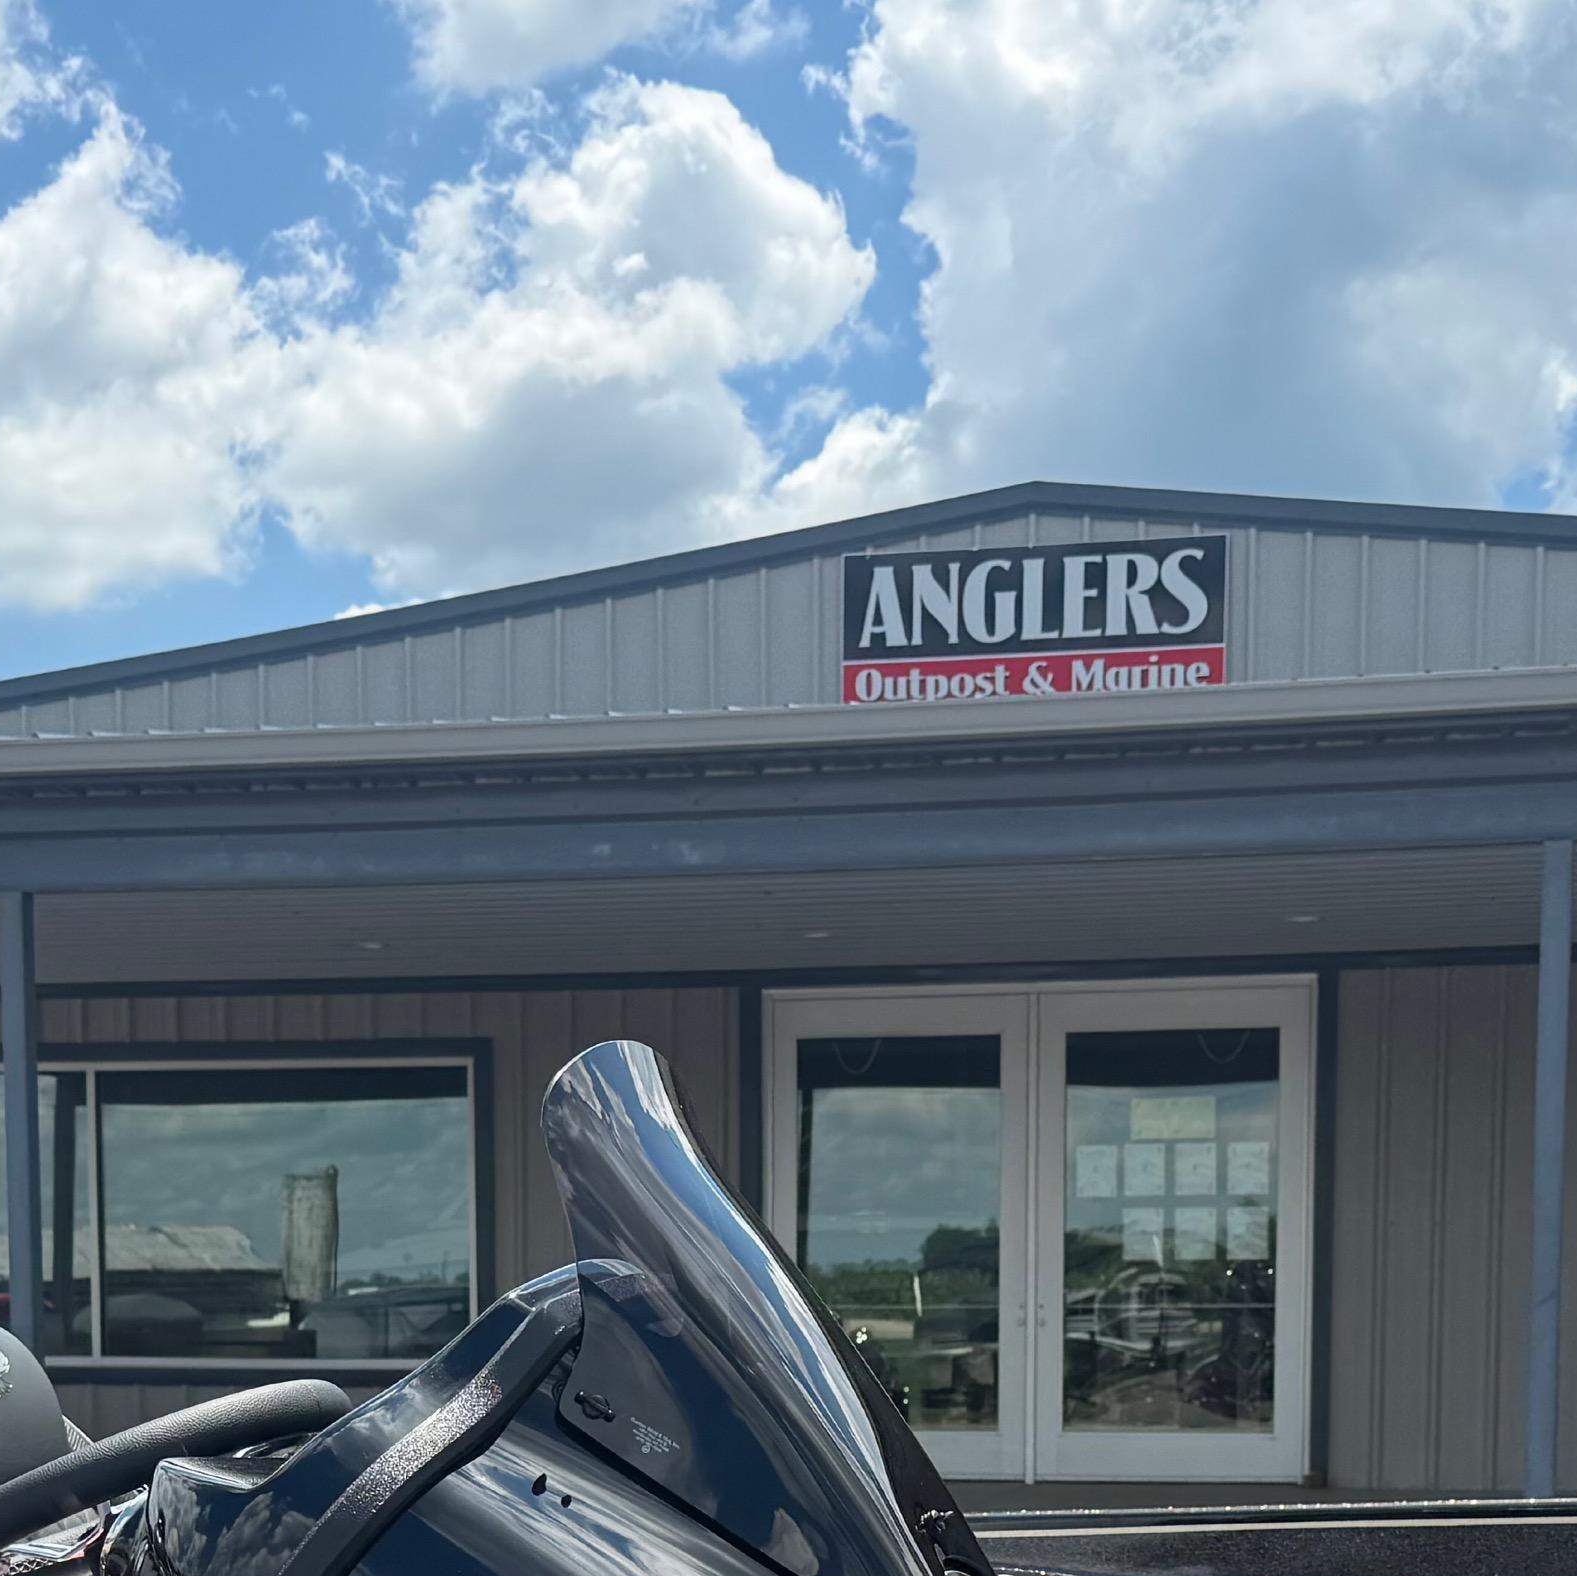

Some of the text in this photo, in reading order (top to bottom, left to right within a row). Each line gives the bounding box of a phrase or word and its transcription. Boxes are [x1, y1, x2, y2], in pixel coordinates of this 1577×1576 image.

[858, 548, 1209, 648] ANGLERS
[855, 654, 1210, 701] Outpost & Marine
